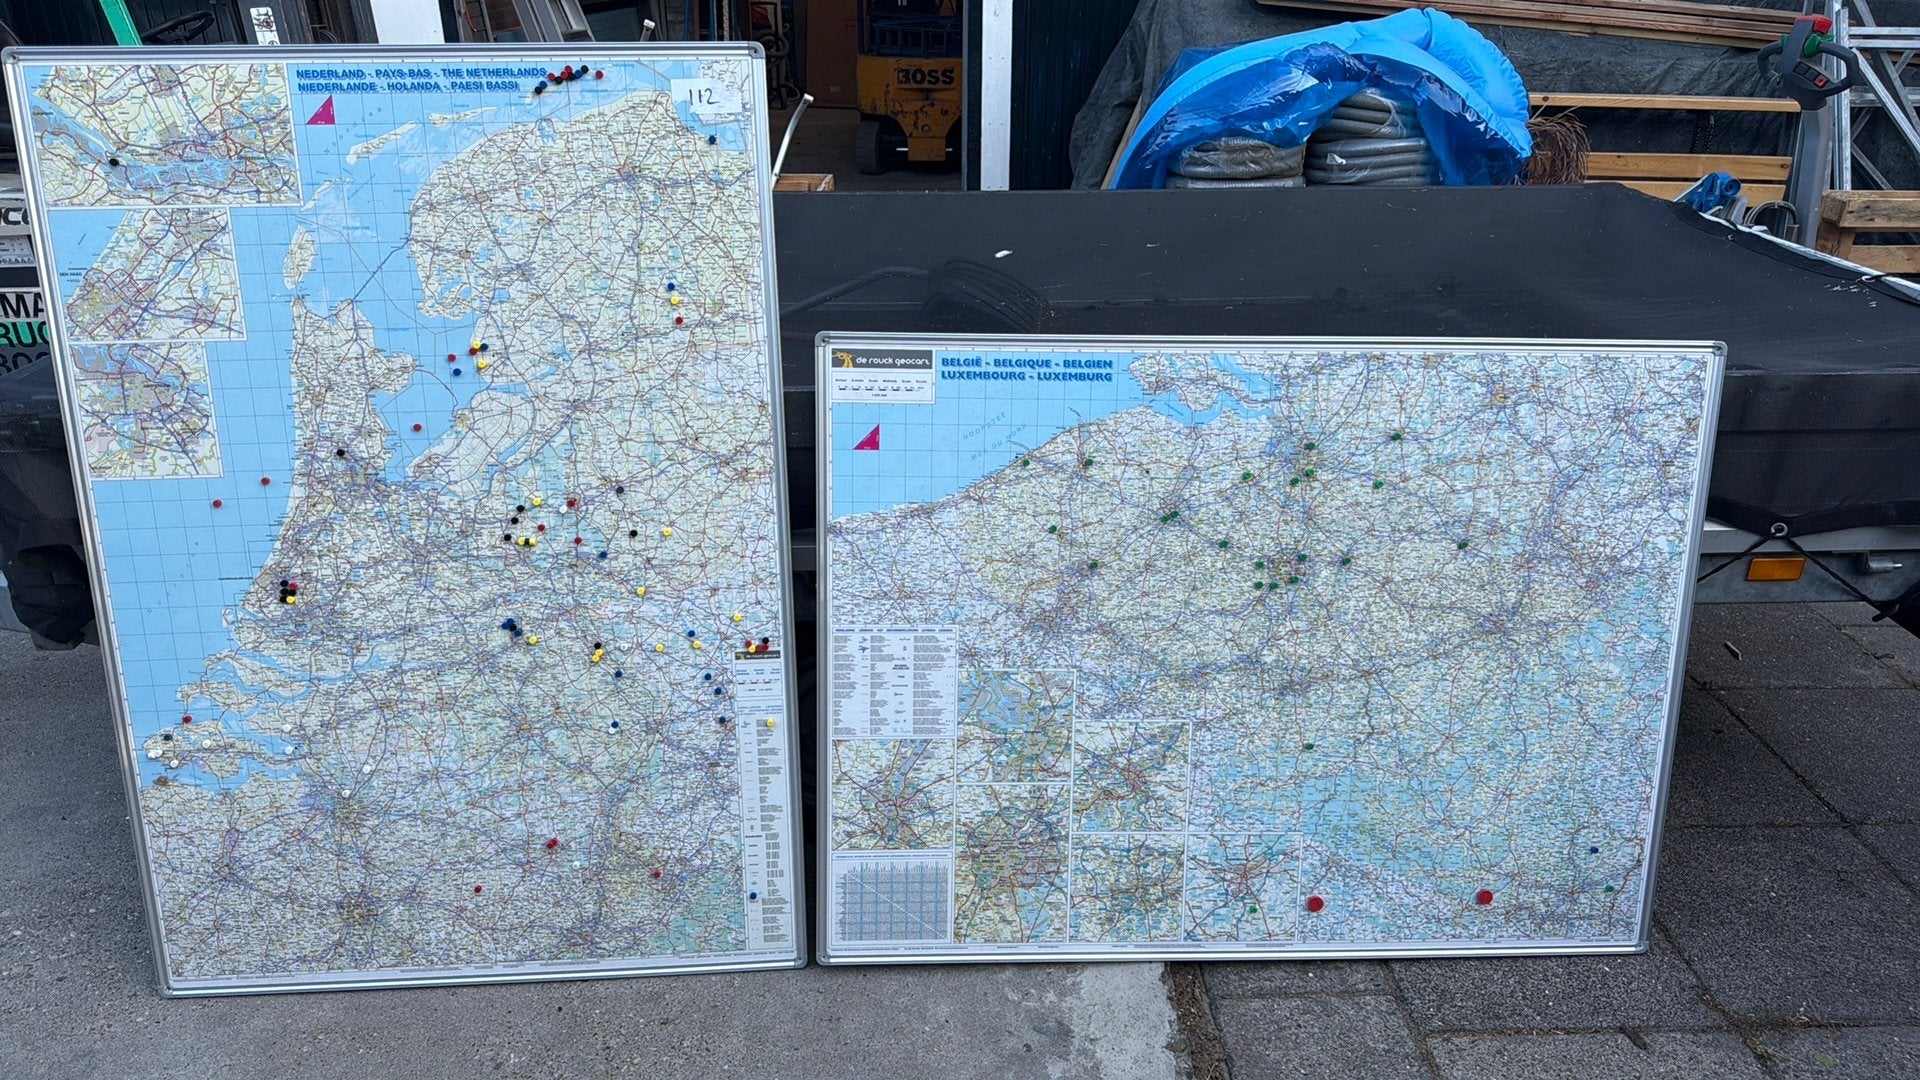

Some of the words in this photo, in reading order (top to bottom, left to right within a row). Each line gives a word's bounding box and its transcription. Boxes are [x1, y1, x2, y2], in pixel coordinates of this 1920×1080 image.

[296, 69, 366, 79] NEDERLAND
[375, 68, 432, 79] PAYS-BAS
[441, 68, 464, 78] THE
[466, 67, 548, 78] NETHERLANDS
[298, 82, 377, 92] NIEDERLANDE
[387, 81, 441, 91] HOLANDA
[451, 80, 484, 90] PAESI
[486, 80, 519, 90] BASSI
[689, 87, 720, 106] 112
[856, 356, 867, 364] de
[868, 356, 893, 365] rouck
[894, 357, 930, 367] geocart
[941, 355, 983, 367] BELGIË
[993, 358, 1053, 369] BELGIQUE
[1062, 359, 1113, 369] BELGIEN
[941, 370, 1026, 381] LUXEMBOURG
[1037, 372, 1113, 382] LUXEMBURG
